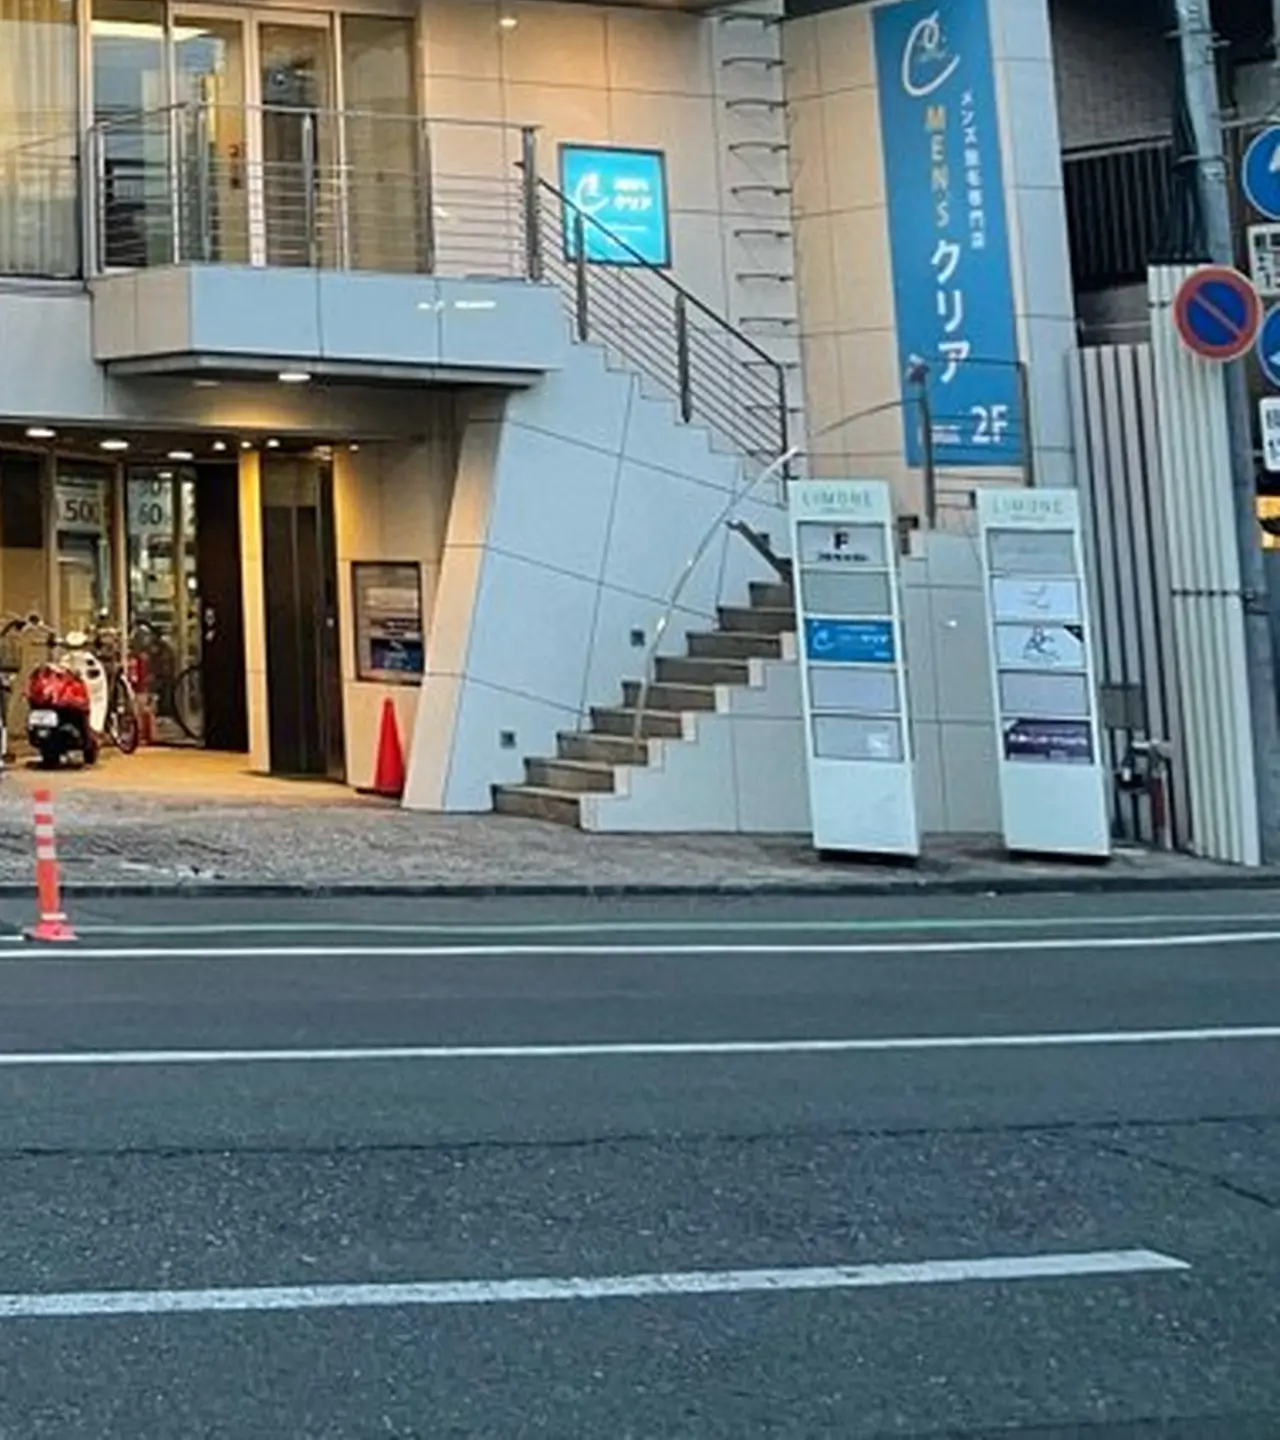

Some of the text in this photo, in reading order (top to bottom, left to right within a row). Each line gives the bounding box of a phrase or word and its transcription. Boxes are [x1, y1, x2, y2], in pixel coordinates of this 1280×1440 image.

[931, 240, 971, 384] クリア
[970, 404, 1009, 444] 2F
